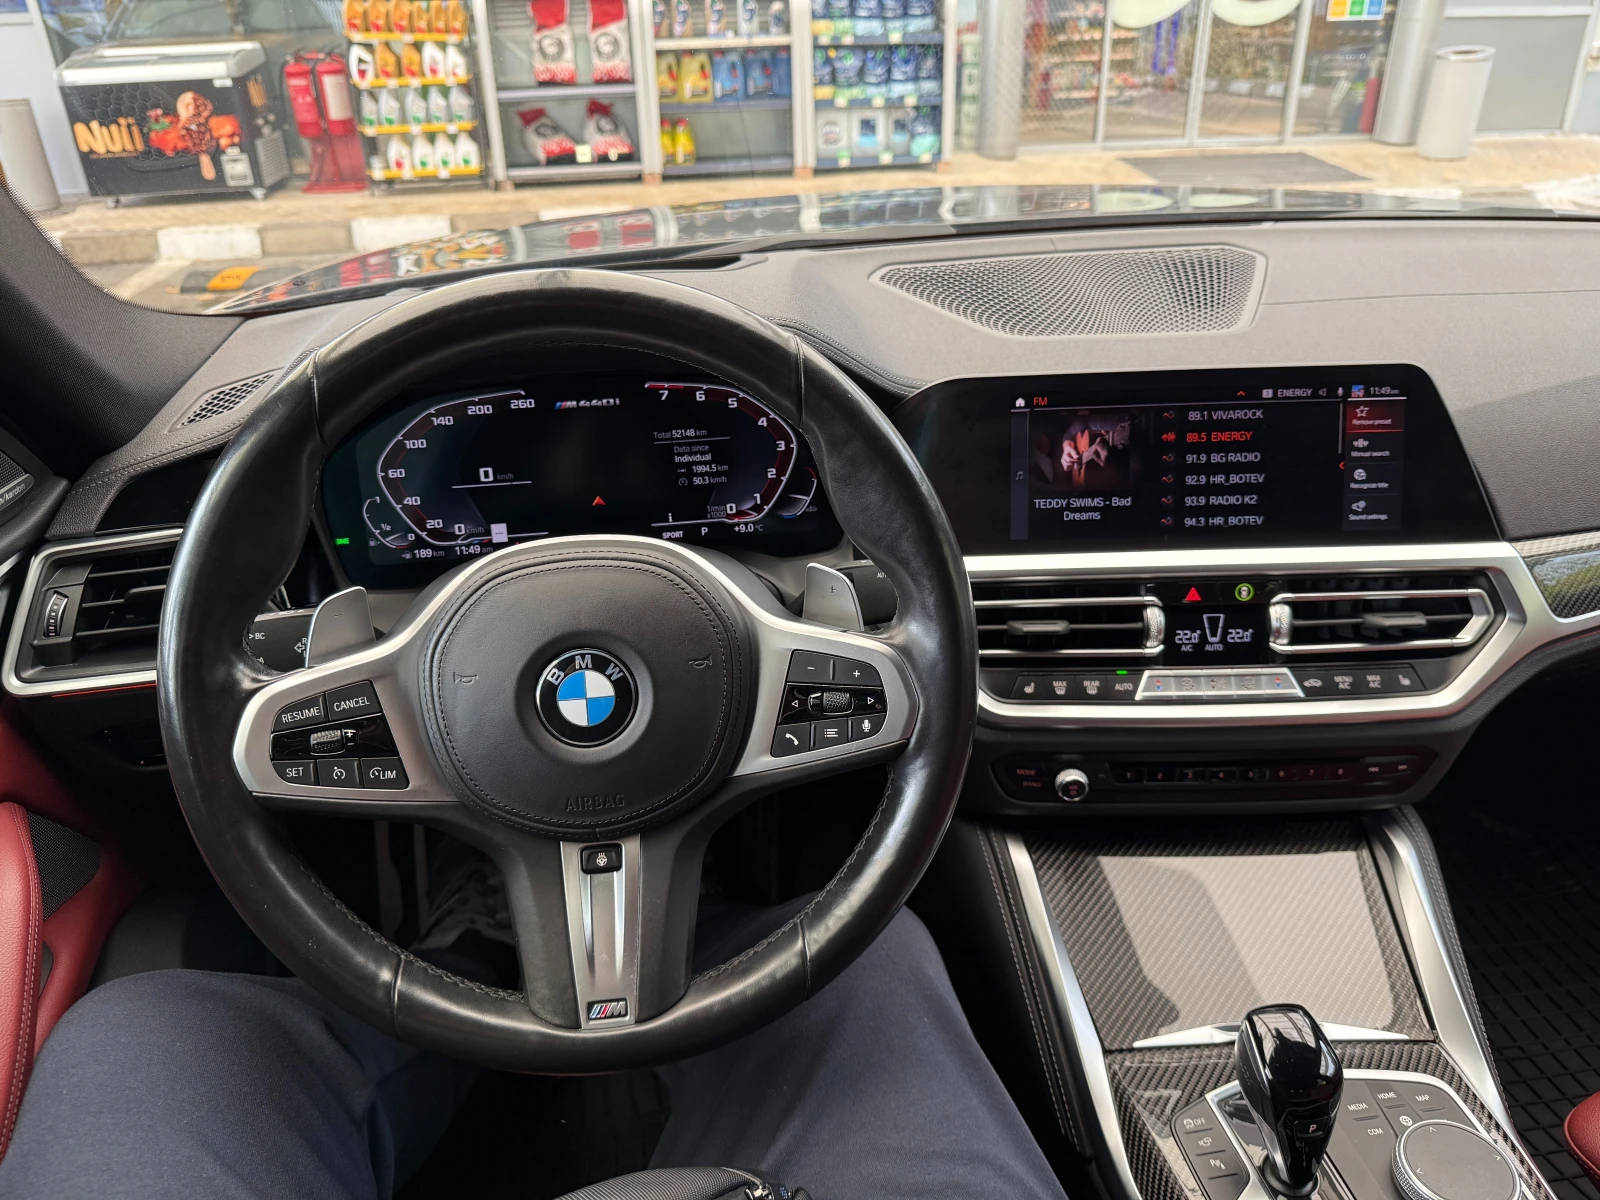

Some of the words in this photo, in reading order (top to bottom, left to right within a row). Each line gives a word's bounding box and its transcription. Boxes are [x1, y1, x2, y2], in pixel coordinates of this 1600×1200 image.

[73, 116, 145, 154] Nuii
[658, 390, 669, 400] 7
[695, 391, 706, 401] 6
[1277, 388, 1313, 397] ENERGY
[510, 399, 535, 409] 260
[728, 398, 738, 408] 5
[1033, 397, 1048, 406] FM
[467, 405, 493, 415] 200
[1188, 411, 1208, 421] 89.1
[1211, 409, 1264, 420] VIVAROCK
[431, 416, 454, 426] 140
[757, 417, 768, 427] 4
[653, 431, 671, 439] Total
[672, 429, 695, 438] 52148
[1186, 433, 1207, 442] 89.5
[1211, 431, 1253, 442] ENERGY
[404, 439, 427, 449] 100
[691, 444, 710, 452] since
[776, 441, 786, 451] 3
[674, 453, 712, 463] Individual
[1185, 454, 1206, 464] 91.9
[1210, 453, 1226, 463] BG
[1228, 452, 1261, 462] RADIO
[388, 469, 406, 478] 60
[692, 464, 717, 473] 1994.5
[767, 468, 777, 479] 2
[479, 467, 494, 482] 0
[1185, 475, 1206, 485] 92.9
[1210, 473, 1265, 485] HR_BOTEV
[692, 476, 709, 485] 50.3
[403, 496, 421, 505] 40
[753, 493, 761, 504] 1
[1034, 498, 1068, 508] TEDDY
[1069, 497, 1104, 508] SWIMS
[1111, 496, 1131, 506] Bad
[1184, 496, 1205, 506] 93.9
[1209, 495, 1242, 505] RADIO
[1243, 495, 1257, 504] K2
[726, 503, 737, 514] 0
[1063, 511, 1101, 521] Dreams
[1184, 517, 1205, 527] 94.3
[1208, 515, 1264, 527] HR_BOTEV
[426, 519, 443, 529] 20
[454, 523, 465, 535] 0
[662, 531, 683, 539] SPORT
[701, 527, 708, 536] P
[408, 533, 415, 541] 0
[414, 549, 433, 559] 189
[454, 545, 481, 556] 11:49
[1181, 644, 1194, 652] A/C
[546, 654, 624, 686] BMW
[1115, 682, 1133, 691] AUTO
[334, 696, 370, 712] CANCEL
[282, 706, 321, 724] RESUME
[286, 767, 304, 777] SET
[380, 769, 396, 780] LIM
[566, 794, 625, 812] AIRBAG
[1377, 1092, 1397, 1100] HOME
[1347, 1103, 1368, 1111] MEDIA
[1193, 1117, 1205, 1126] OFF
[1309, 1124, 1317, 1133] P
[1367, 1128, 1383, 1136] COM
